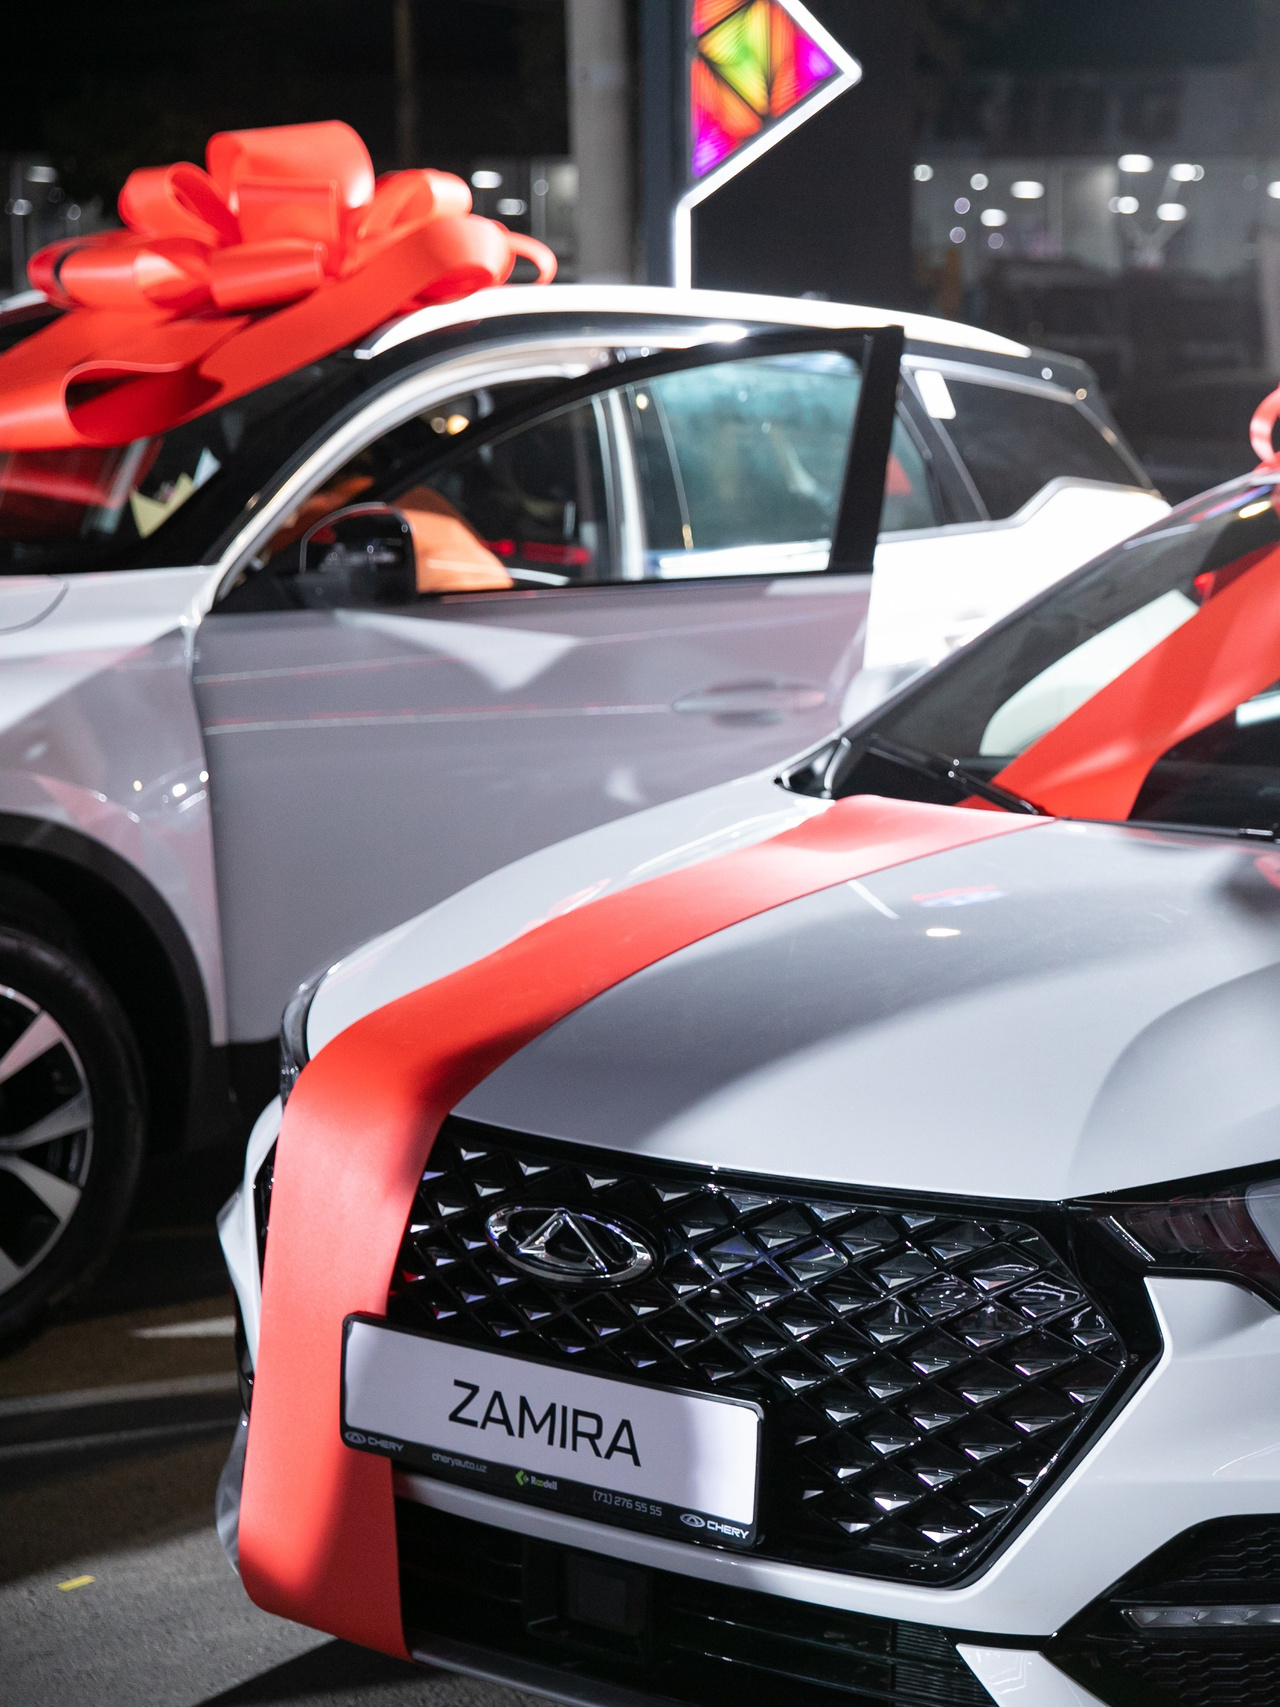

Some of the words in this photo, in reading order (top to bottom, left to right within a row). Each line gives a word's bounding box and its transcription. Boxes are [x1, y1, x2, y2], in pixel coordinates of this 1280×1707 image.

[448, 1379, 642, 1467] ZAMIRA
[368, 1436, 404, 1452] CHERY
[431, 1452, 488, 1473] cheryauto.uz
[592, 1490, 612, 1505] (71)
[614, 1496, 633, 1509] 276
[635, 1501, 648, 1513] 55
[650, 1505, 662, 1517] 55
[707, 1521, 750, 1540] CHERY
